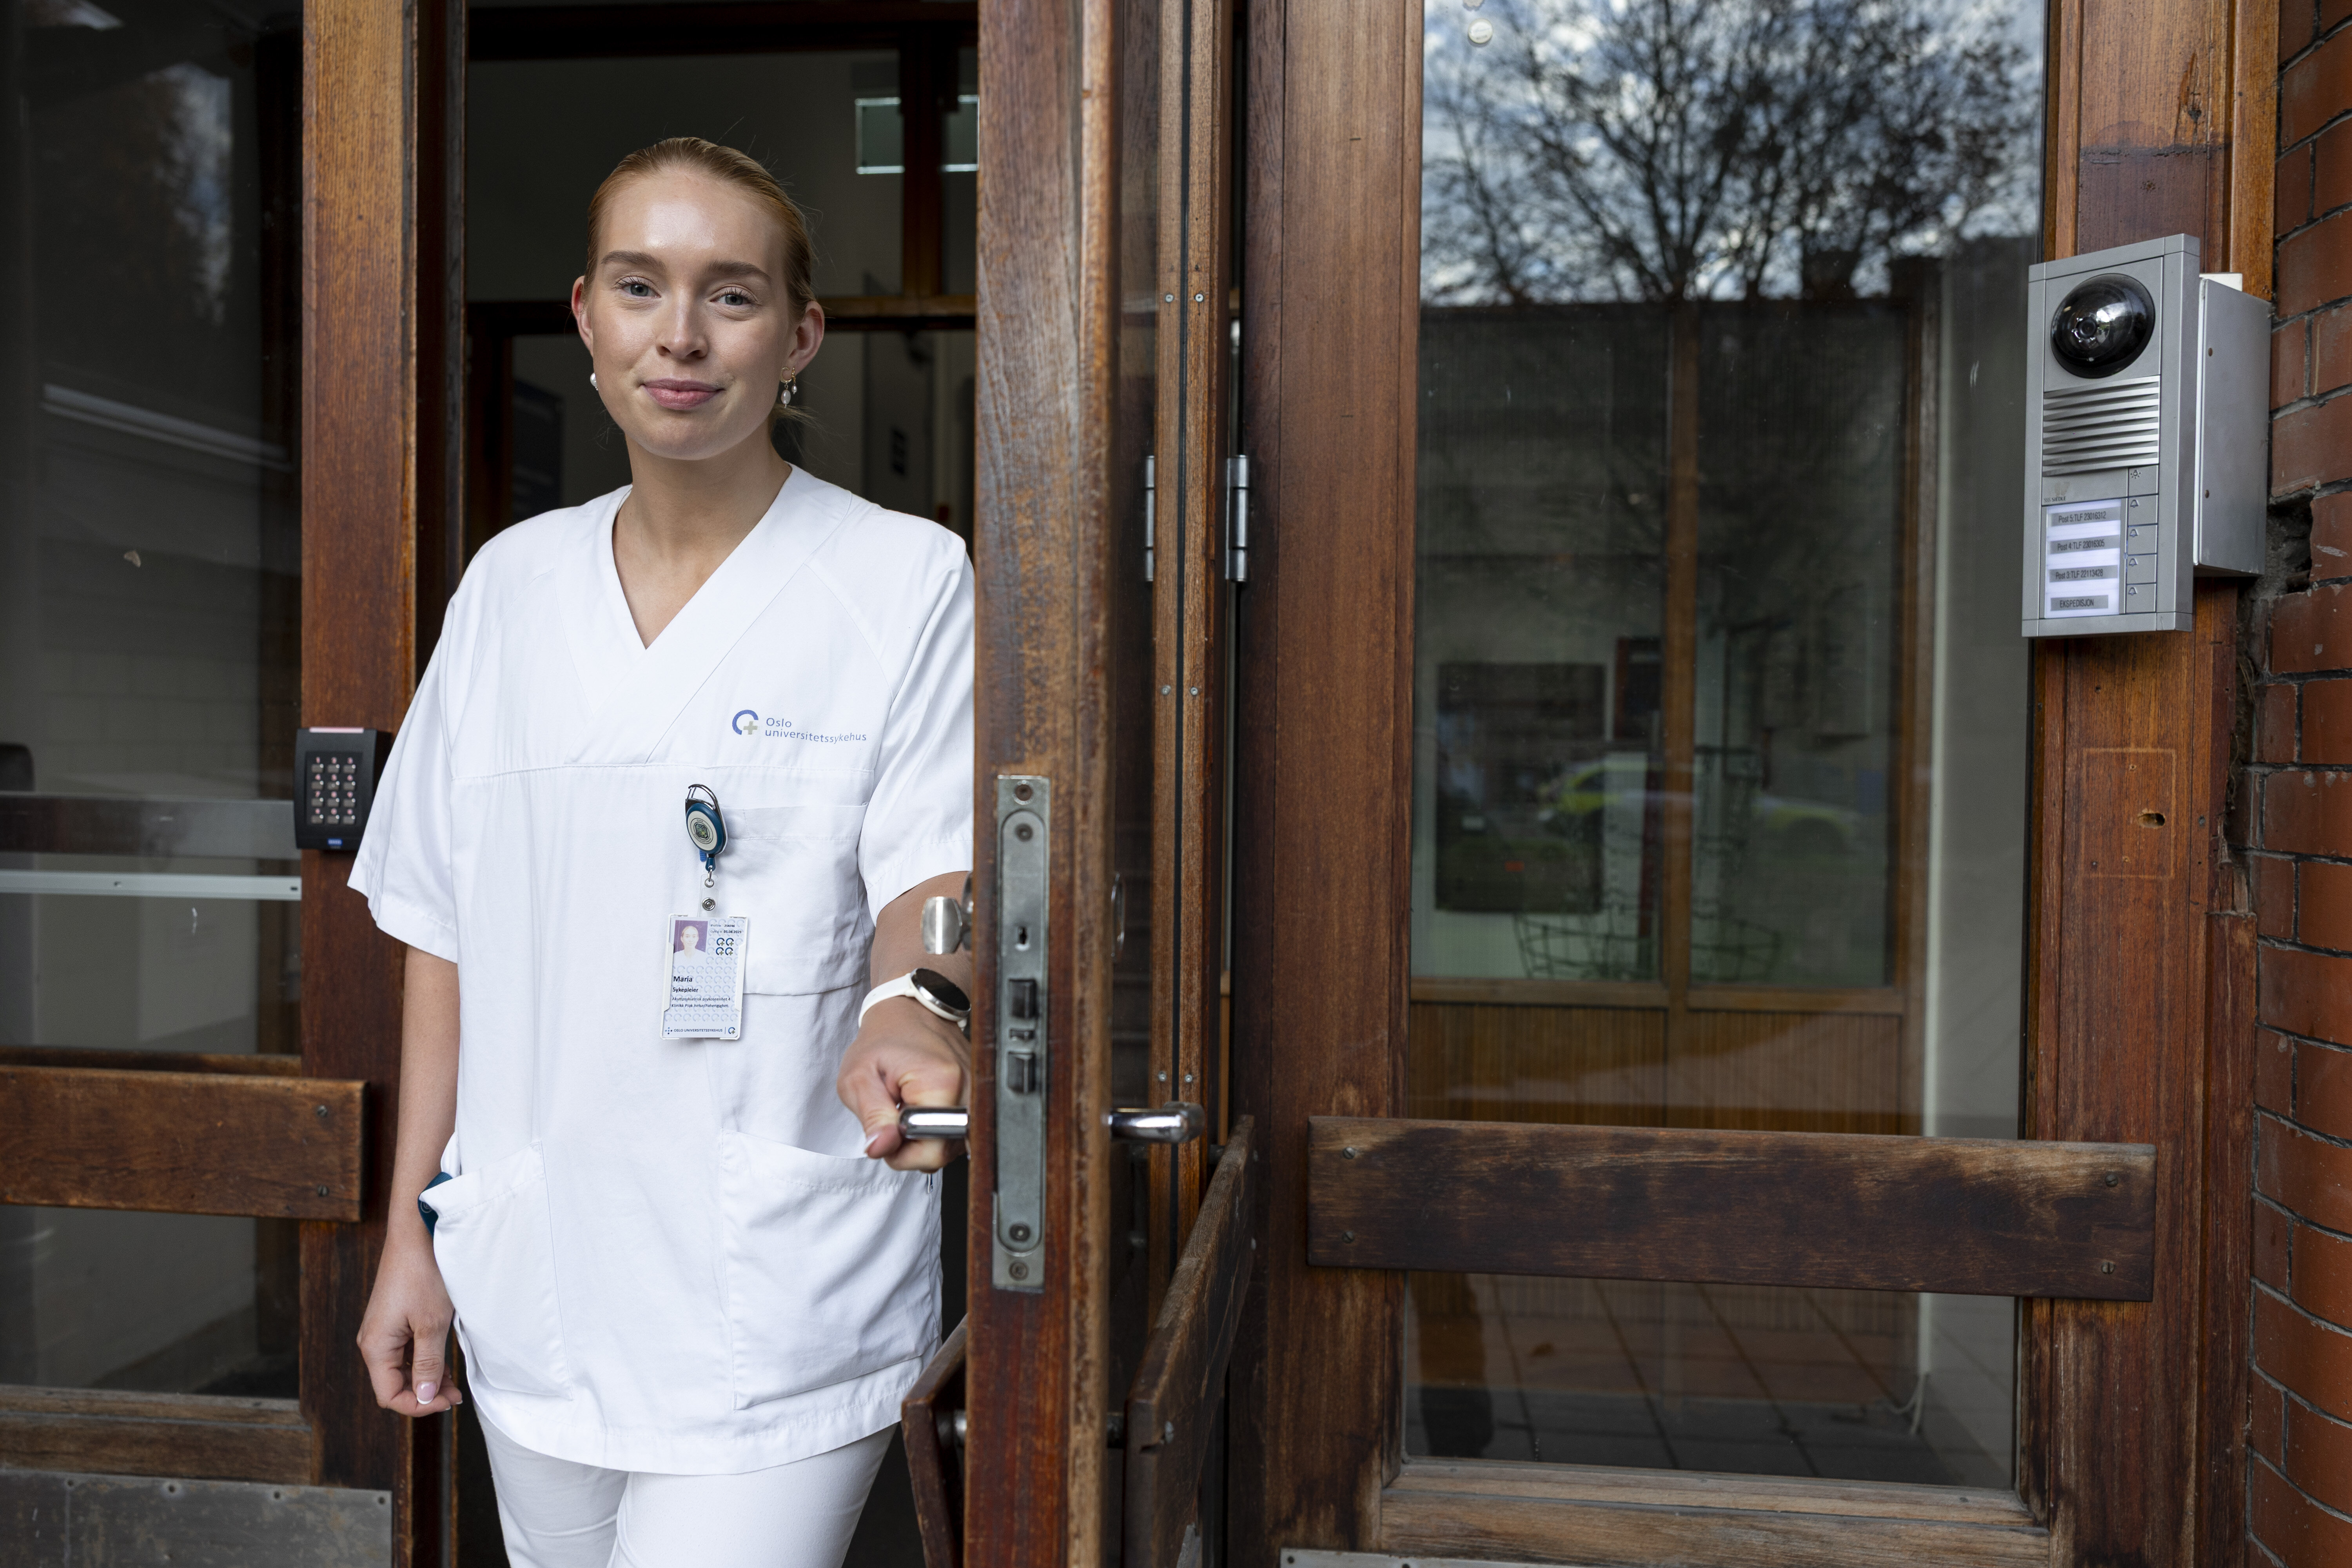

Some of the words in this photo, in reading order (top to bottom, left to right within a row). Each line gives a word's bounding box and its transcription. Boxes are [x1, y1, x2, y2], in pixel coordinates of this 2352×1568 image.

[2084, 511, 2106, 521] 23016312
[2083, 539, 2105, 549] 23016305
[2081, 569, 2103, 578] 22113428
[2060, 599, 2094, 608] EKSPEDISJON
[766, 718, 792, 728] Oslo
[765, 729, 867, 744] universitetssykehus
